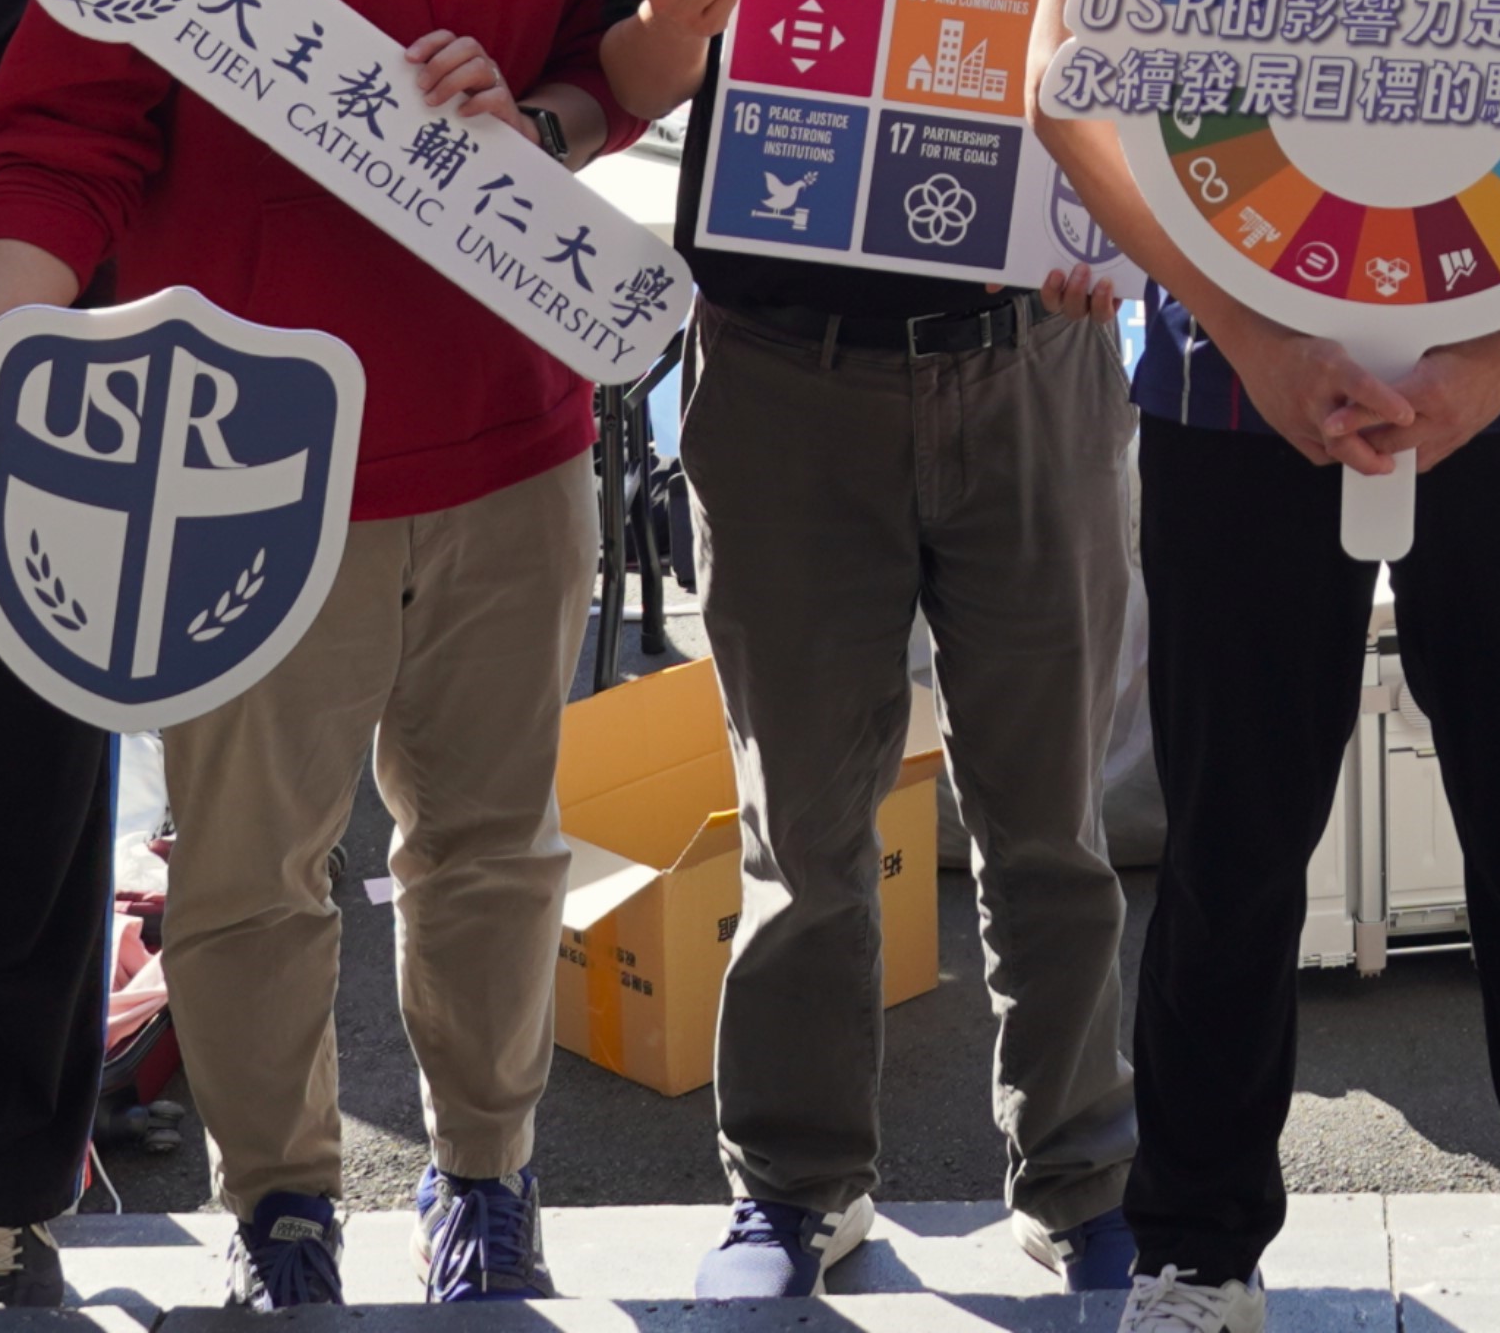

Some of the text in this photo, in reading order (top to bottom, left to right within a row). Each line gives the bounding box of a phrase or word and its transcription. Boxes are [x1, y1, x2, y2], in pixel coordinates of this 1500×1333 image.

[732, 101, 761, 135] 16
[805, 109, 850, 130] JUSTICE
[766, 122, 833, 145] AND STRONG
[889, 122, 1002, 156] 17 PARTNERSHIPS
[762, 140, 836, 163] INSTITUTIONS
[920, 143, 999, 167] FOR THE GOALS
[173, 18, 637, 366] FUJEN CATHOLIC UNIVERSITY
